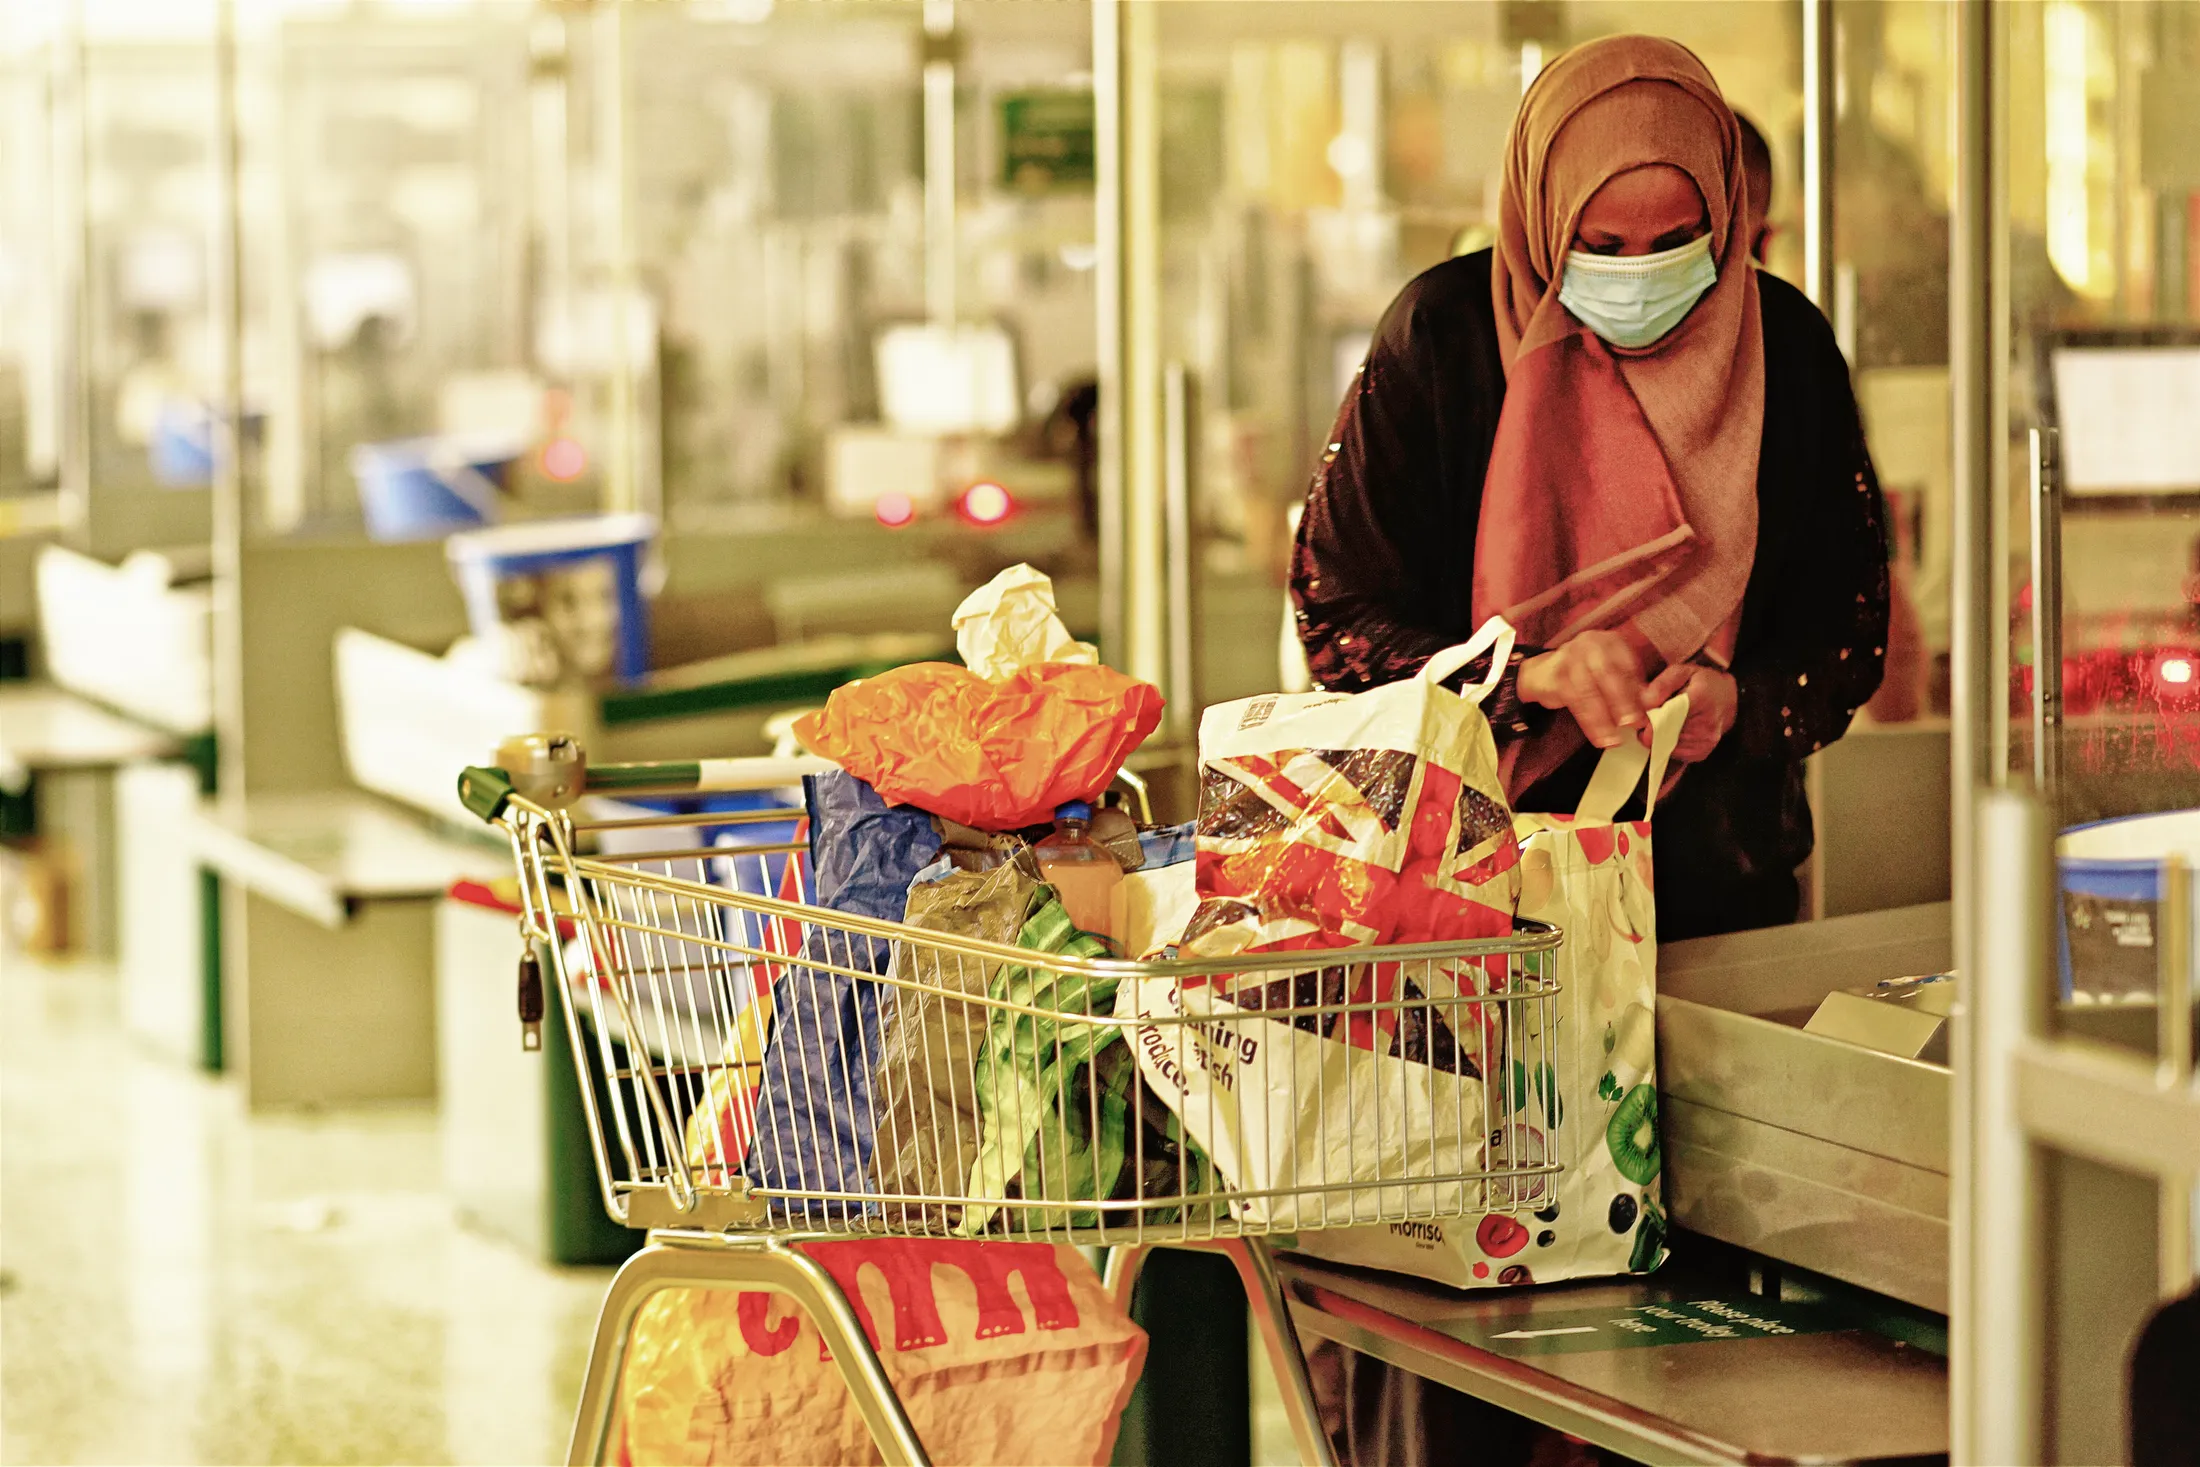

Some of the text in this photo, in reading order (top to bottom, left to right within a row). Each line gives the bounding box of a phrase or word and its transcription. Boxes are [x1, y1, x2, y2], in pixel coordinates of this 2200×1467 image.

[1389, 1220, 1446, 1247] Morriso
[1686, 1299, 1796, 1335] Please place
